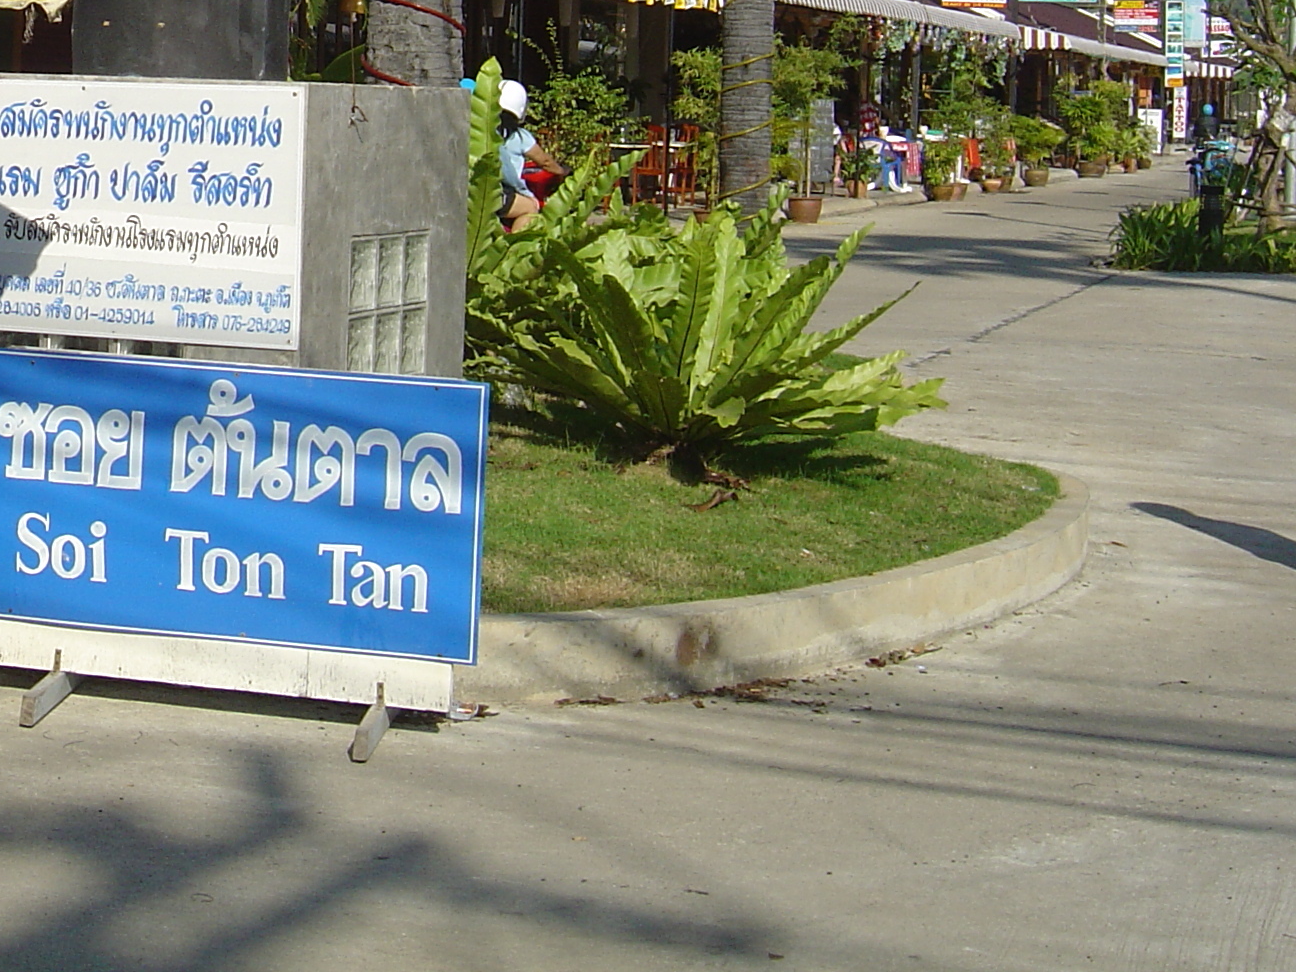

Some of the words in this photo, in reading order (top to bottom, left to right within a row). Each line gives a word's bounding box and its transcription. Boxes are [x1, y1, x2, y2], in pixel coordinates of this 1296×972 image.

[1174, 97, 1185, 132] TATTOO
[169, 378, 463, 515] ต้นตาล
[15, 512, 108, 583] Soi
[165, 527, 286, 600] Ton
[318, 543, 430, 613] Tan
